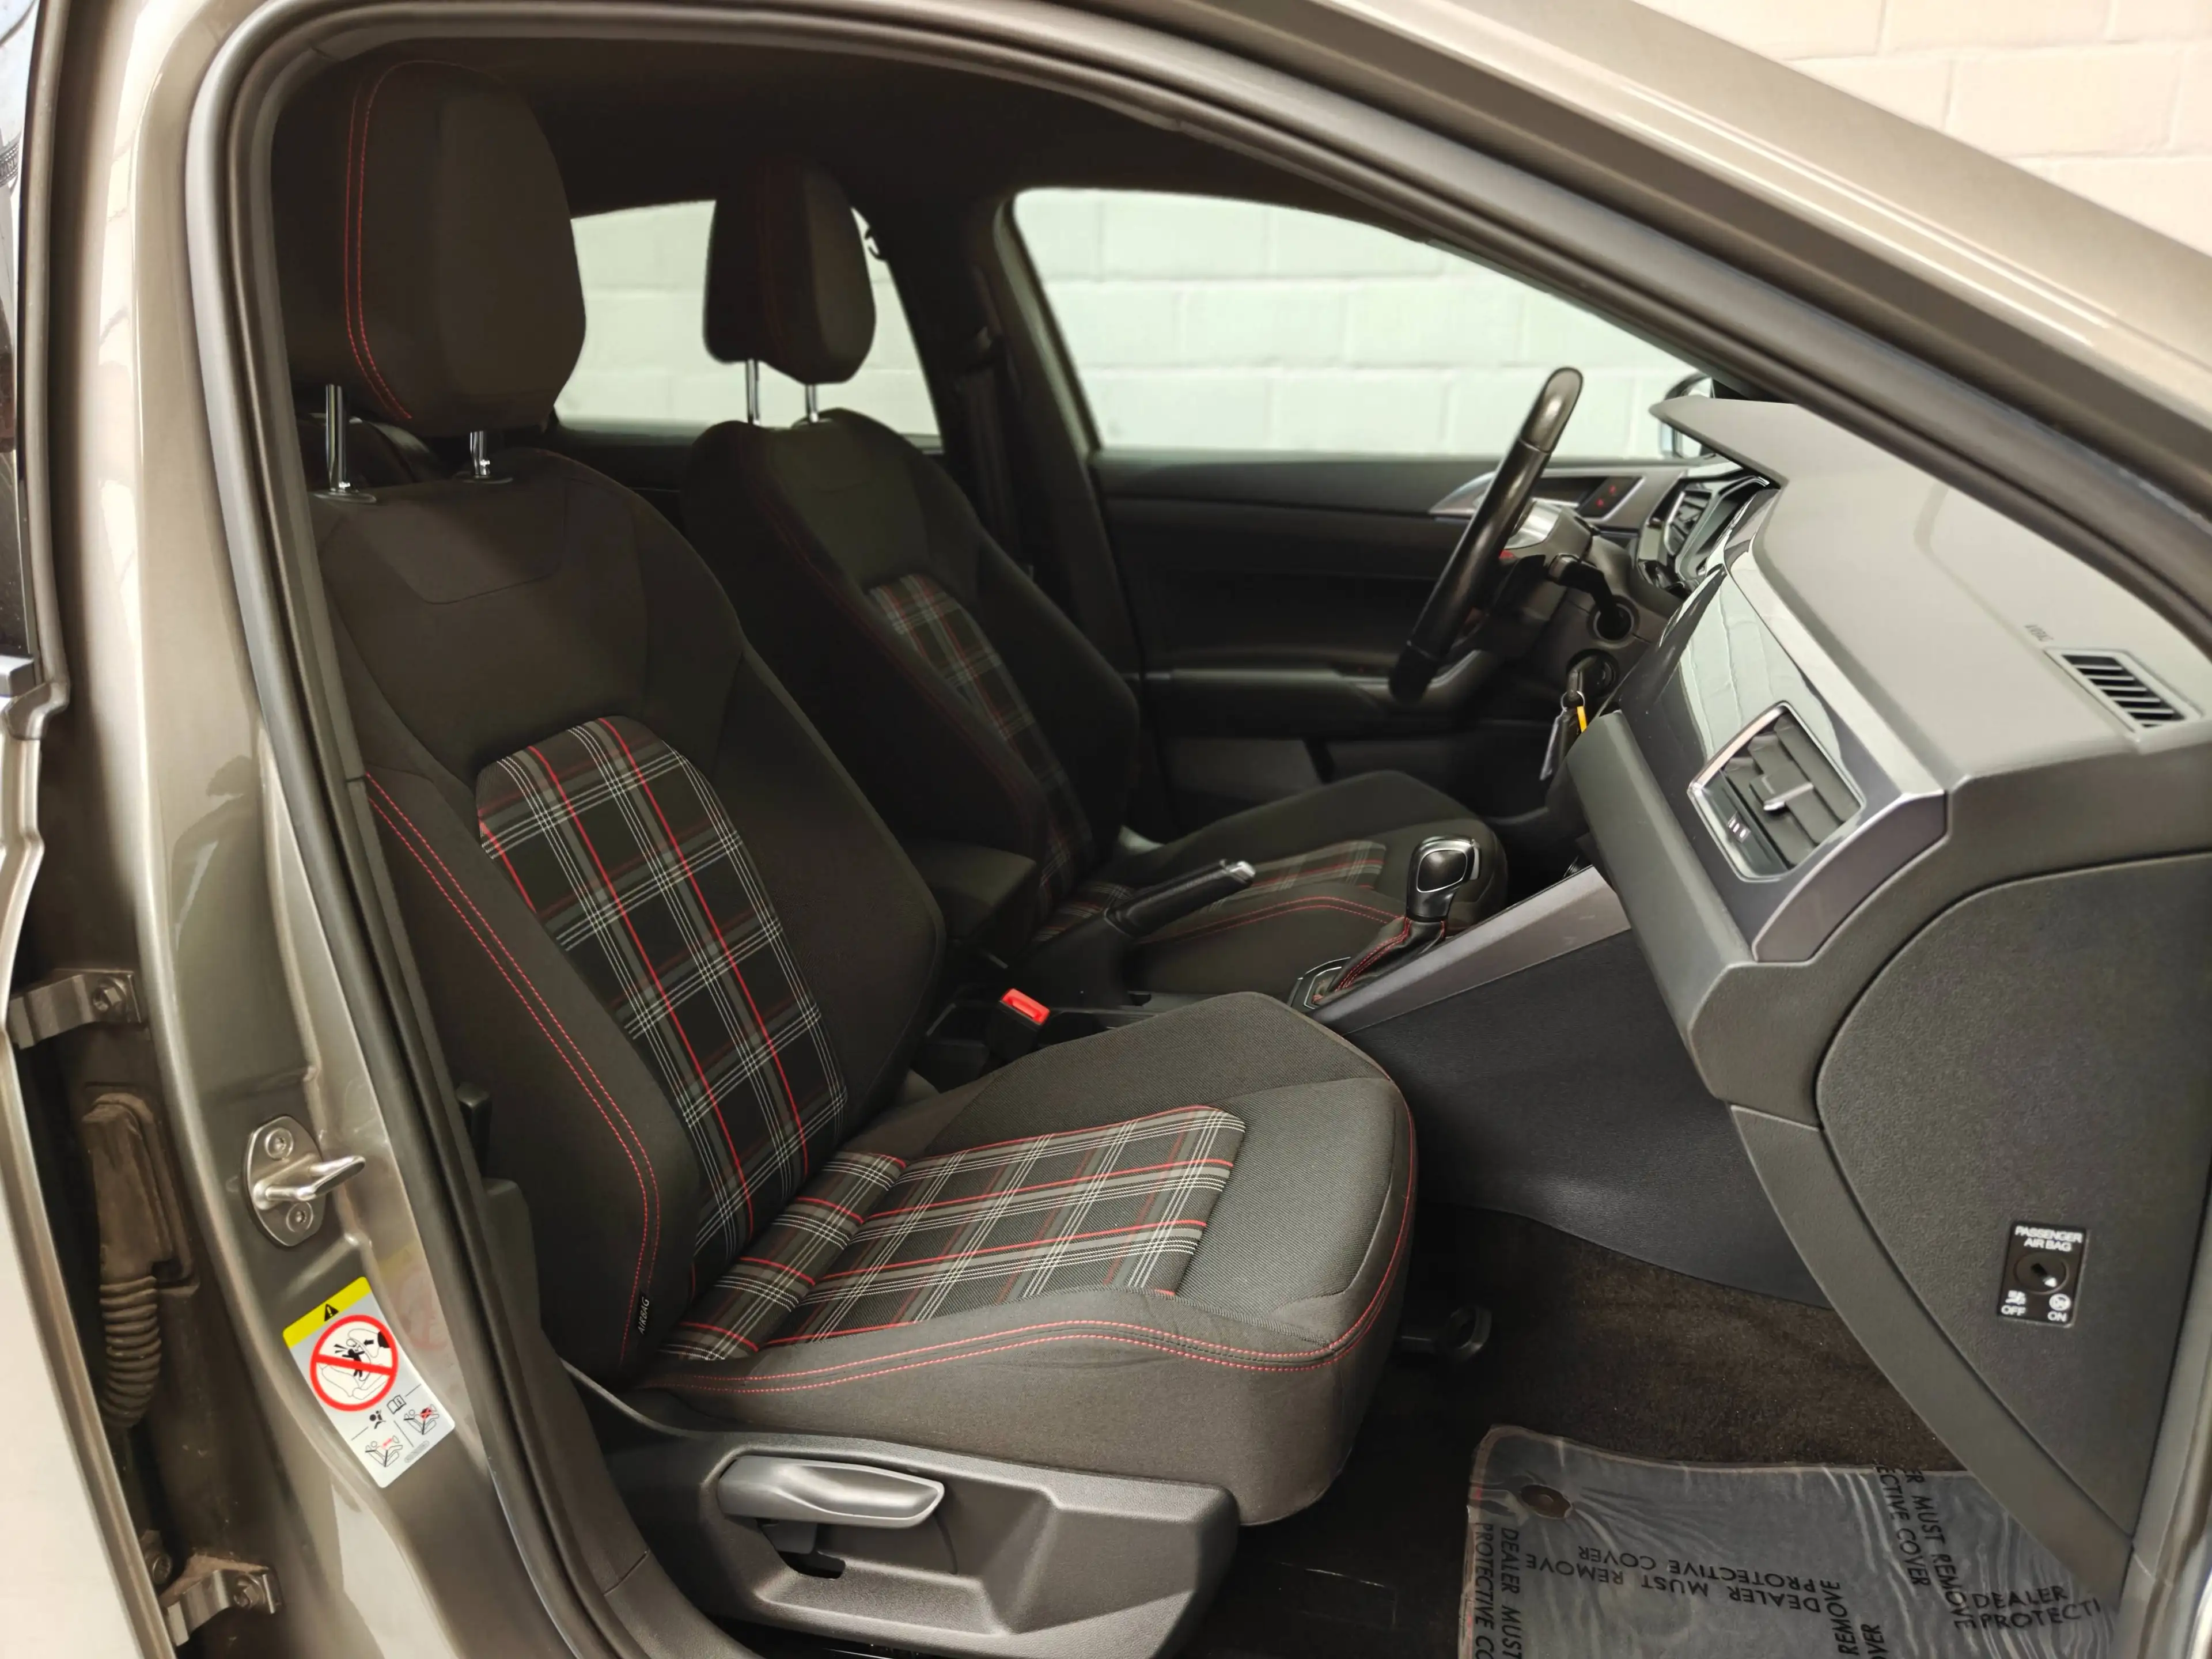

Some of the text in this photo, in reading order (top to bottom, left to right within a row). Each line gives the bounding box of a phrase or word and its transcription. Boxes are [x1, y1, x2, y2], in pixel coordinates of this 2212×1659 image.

[2015, 1225, 2083, 1243] PASSENGER
[638, 1296, 650, 1335] AIRBAG
[2001, 1305, 2026, 1316] OFF
[2047, 1310, 2067, 1322] ON
[1475, 1522, 1495, 1630] PROTECTIVE
[1578, 1546, 1816, 1593] PROTECTIVE COVER
[1897, 1528, 1931, 1586] COVER
[1911, 1495, 1945, 1544] MUST
[1930, 1554, 1976, 1630] REMOVE
[1501, 1527, 1522, 1659] DEALER MUST
[1525, 1554, 1821, 1613] DEALER MUST REMOVE
[1972, 1586, 2068, 1609] DEALER
[1820, 1580, 1860, 1656] REMOVE
[1980, 1597, 2101, 1630] PROTECTI
[1861, 1624, 1890, 1659] VER
